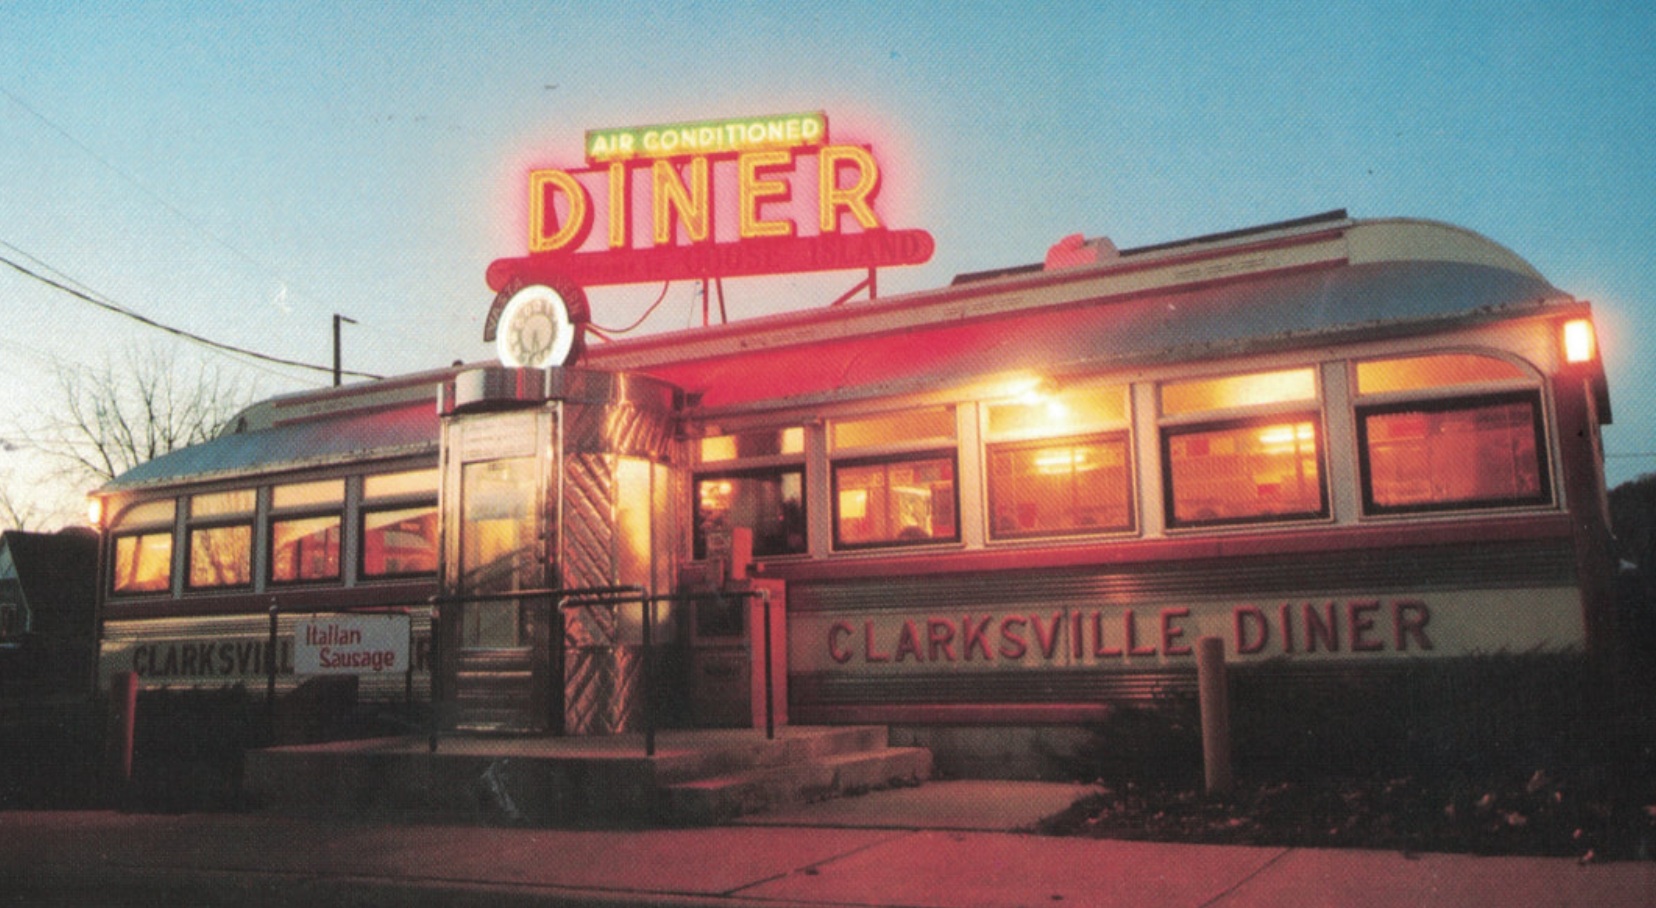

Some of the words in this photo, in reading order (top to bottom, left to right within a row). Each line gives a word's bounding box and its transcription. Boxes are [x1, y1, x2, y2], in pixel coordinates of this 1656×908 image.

[590, 131, 635, 154] AIR
[643, 117, 821, 150] CONDITIONED
[528, 145, 881, 254] DINER
[809, 232, 922, 265] ISLAND
[306, 624, 362, 646] Italian
[828, 604, 1194, 662] CLARKSVILLE
[1235, 597, 1432, 655] DINER
[135, 641, 294, 677] CLARKSVILL
[319, 648, 396, 671] Sausage
